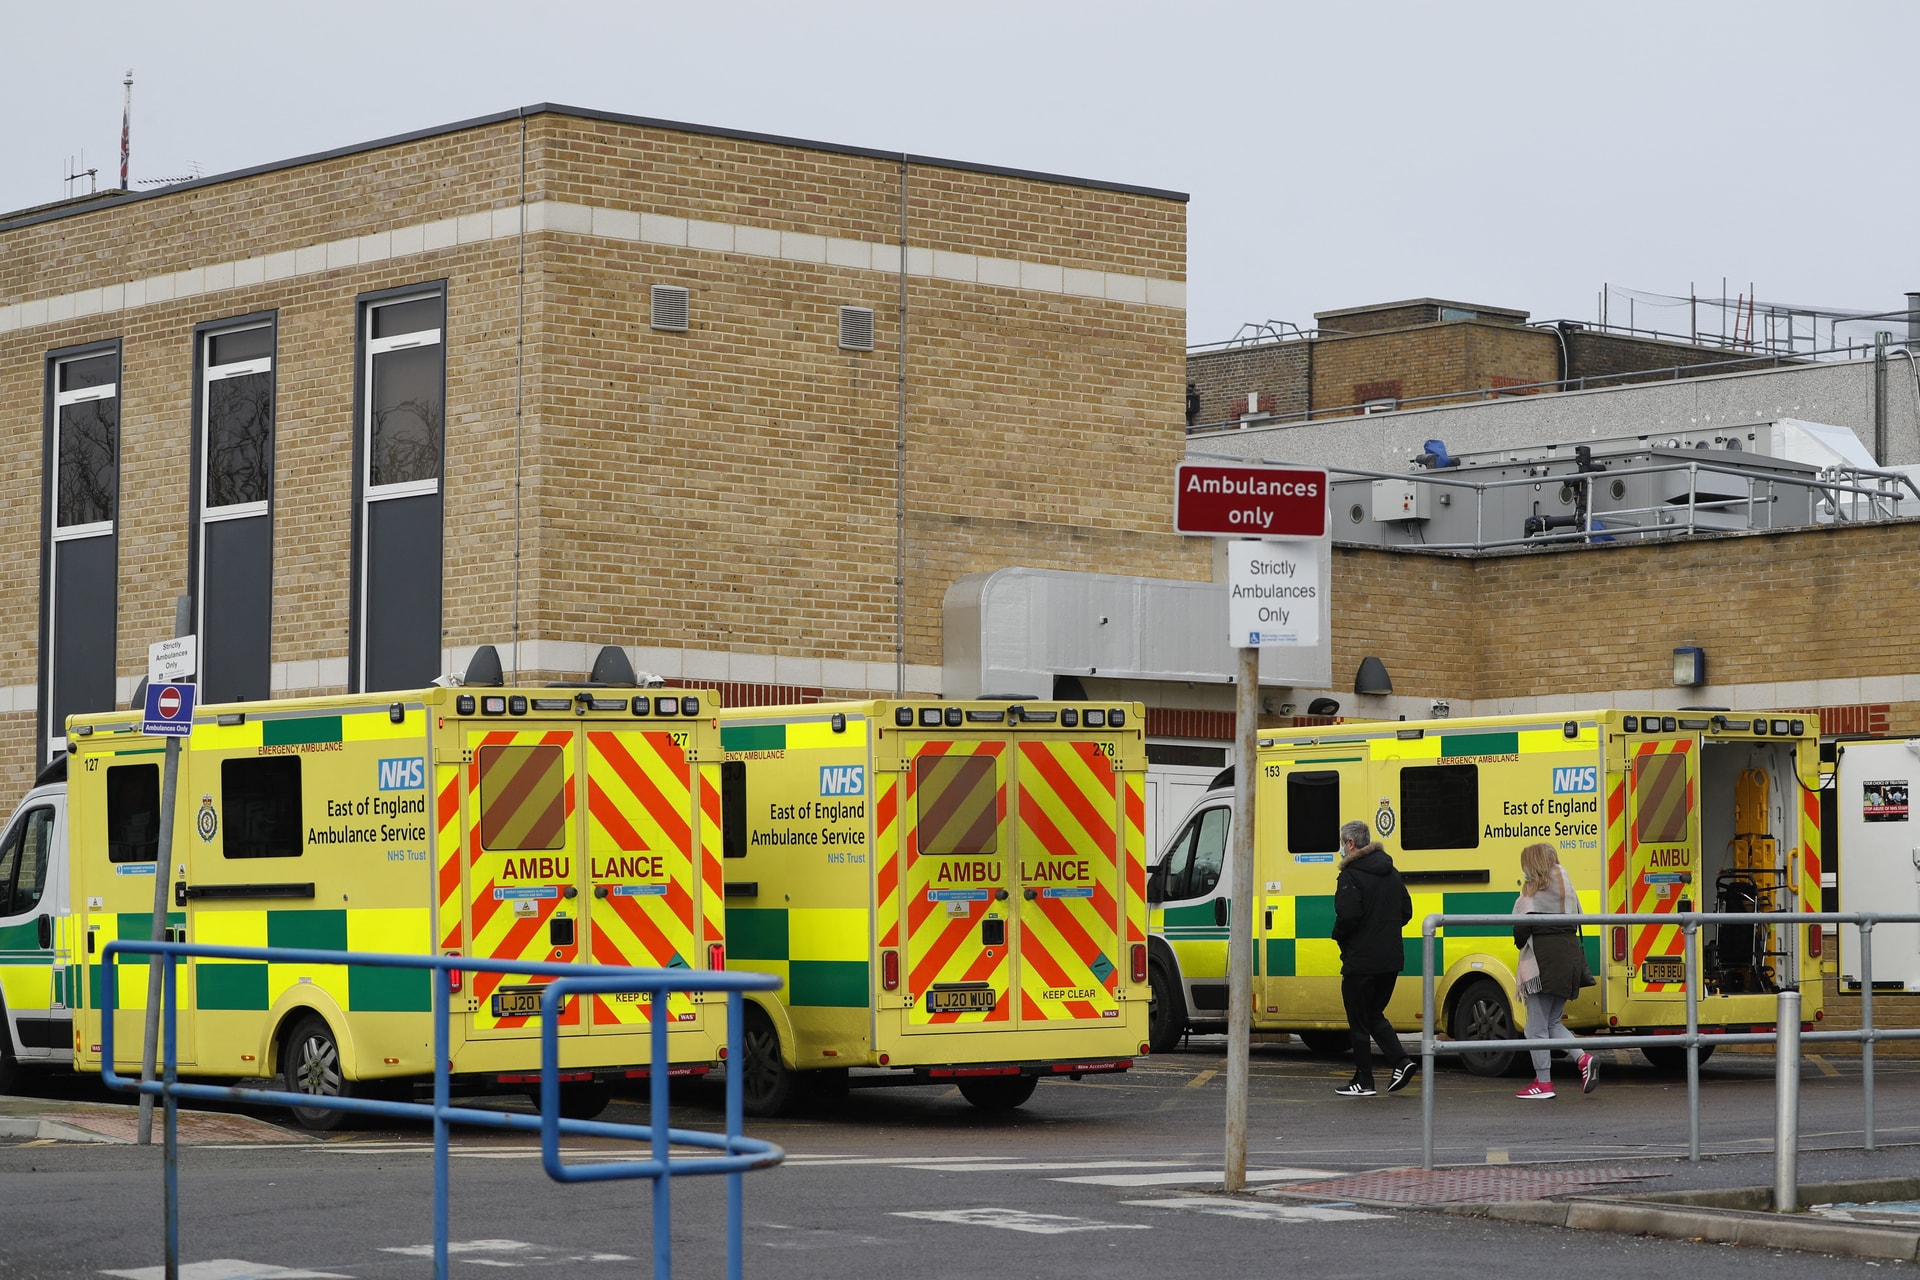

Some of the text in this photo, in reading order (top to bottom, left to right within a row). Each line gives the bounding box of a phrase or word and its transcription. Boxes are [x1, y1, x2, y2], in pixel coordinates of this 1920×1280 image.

[1187, 474, 1318, 497] Ambulances
[1228, 506, 1274, 528] only
[1250, 560, 1296, 578] Strictly
[1232, 584, 1316, 599] Ambulances
[1258, 607, 1290, 625] Only
[162, 641, 181, 651] Strictly
[156, 650, 188, 662] Ambulances
[165, 661, 178, 670] Only
[145, 724, 188, 733] Ambulances Only
[666, 732, 688, 747] 127
[258, 742, 343, 756] EMERGENCY AMBULANCE
[744, 750, 785, 760] AMBULANCE
[1093, 742, 1115, 757] 278
[84, 758, 99, 771] 127
[1437, 754, 1519, 765] EMERGENCY AMBULANCE
[380, 759, 423, 789] NHS
[1264, 765, 1280, 778] 153
[821, 767, 863, 794] NHS
[1554, 767, 1596, 792] NHS
[327, 794, 425, 819] East of England
[770, 801, 865, 823] East of England
[1503, 797, 1597, 817] East of England
[308, 823, 426, 844] Ambulance Service
[751, 827, 865, 846] Ambulance Service
[1484, 820, 1597, 838] Ambulance Service
[1560, 839, 1597, 849] NHS Trust
[387, 849, 426, 861] NHS Trust
[828, 852, 865, 863] NHS Trust
[1650, 848, 1690, 867] AMBU
[502, 856, 664, 879] AMBU LANCE
[937, 860, 1090, 882] AMBU LANCE
[1648, 965, 1683, 978] LF19 BEU
[615, 992, 672, 1002] KEEP CLR
[935, 992, 993, 1008] LJ20 WUO
[1042, 989, 1096, 999] KEEP CLEAR
[501, 995, 535, 1011] LJ20
